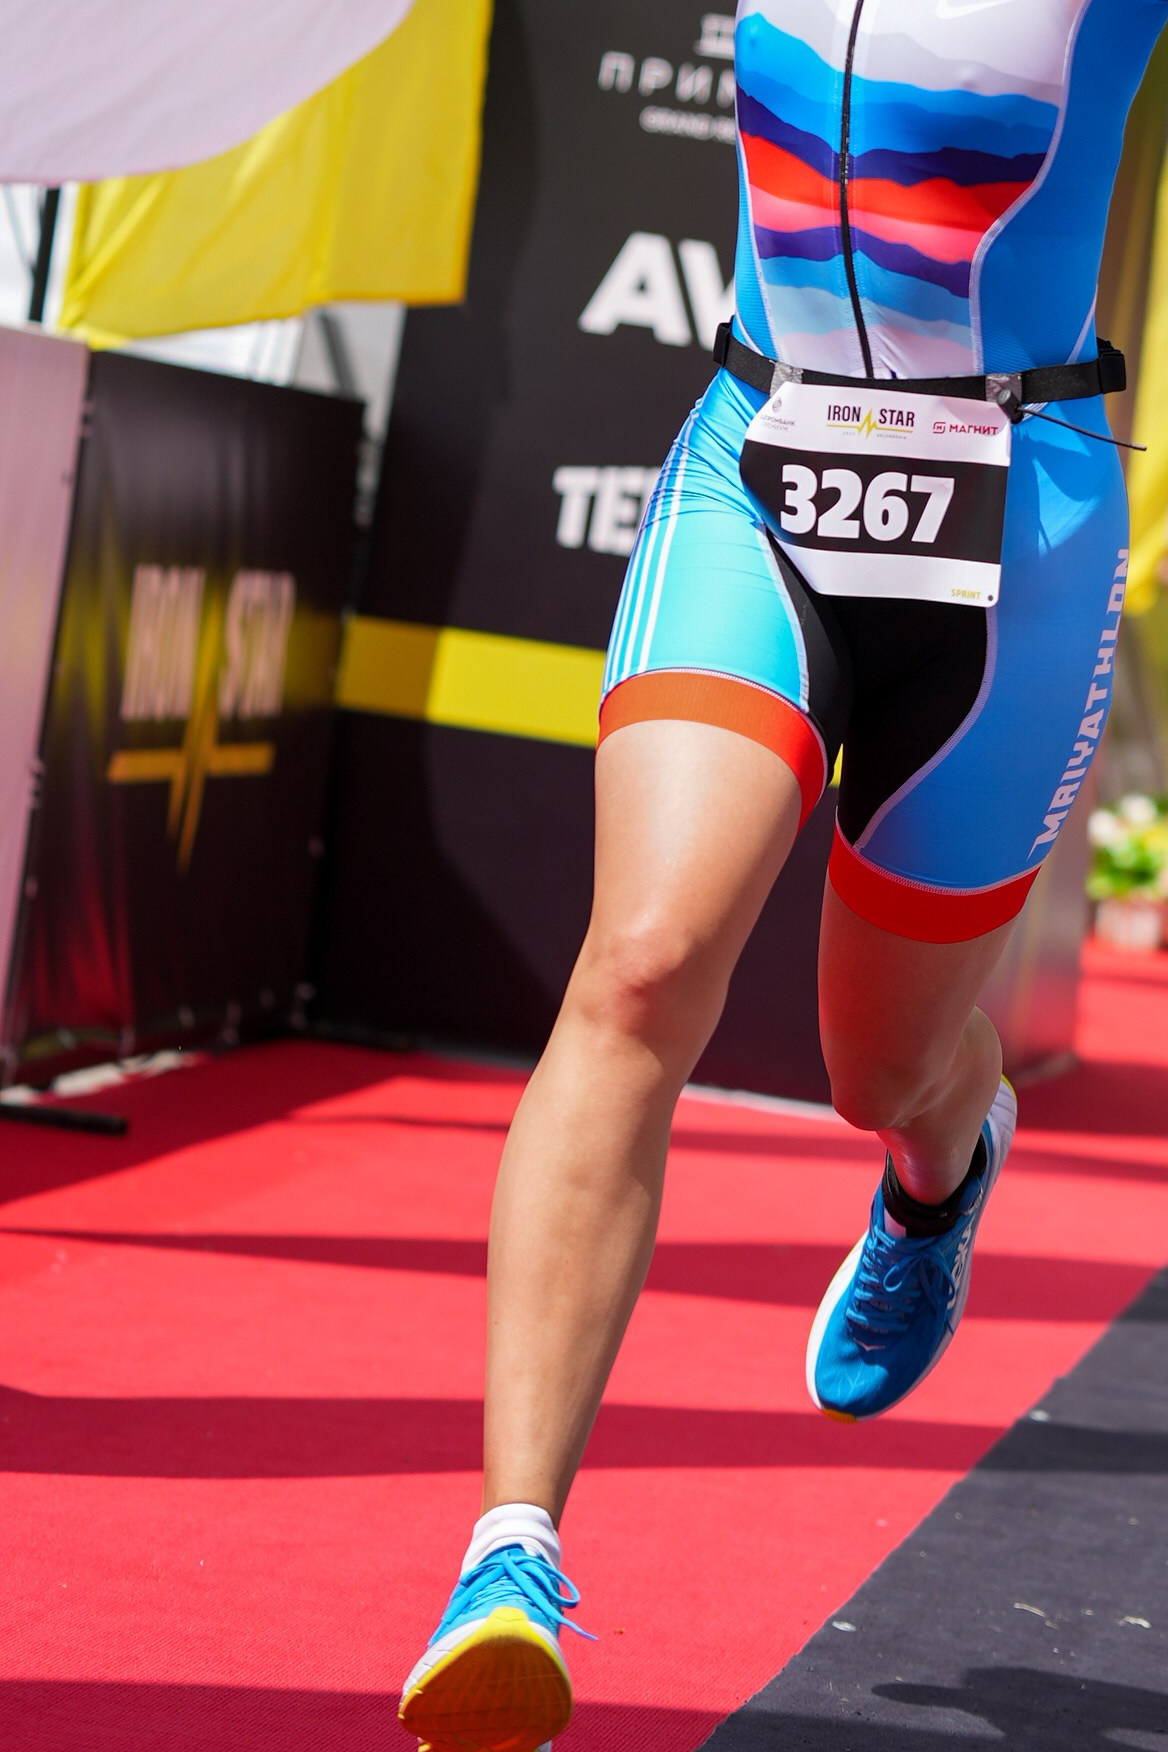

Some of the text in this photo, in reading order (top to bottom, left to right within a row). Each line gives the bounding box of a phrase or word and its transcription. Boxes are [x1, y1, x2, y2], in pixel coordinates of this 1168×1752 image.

[827, 404, 916, 428] IRON STAR
[949, 424, 999, 436] МАГНИТ
[553, 466, 661, 557] TE
[780, 464, 955, 543] 3267
[951, 588, 981, 600] SPRINT
